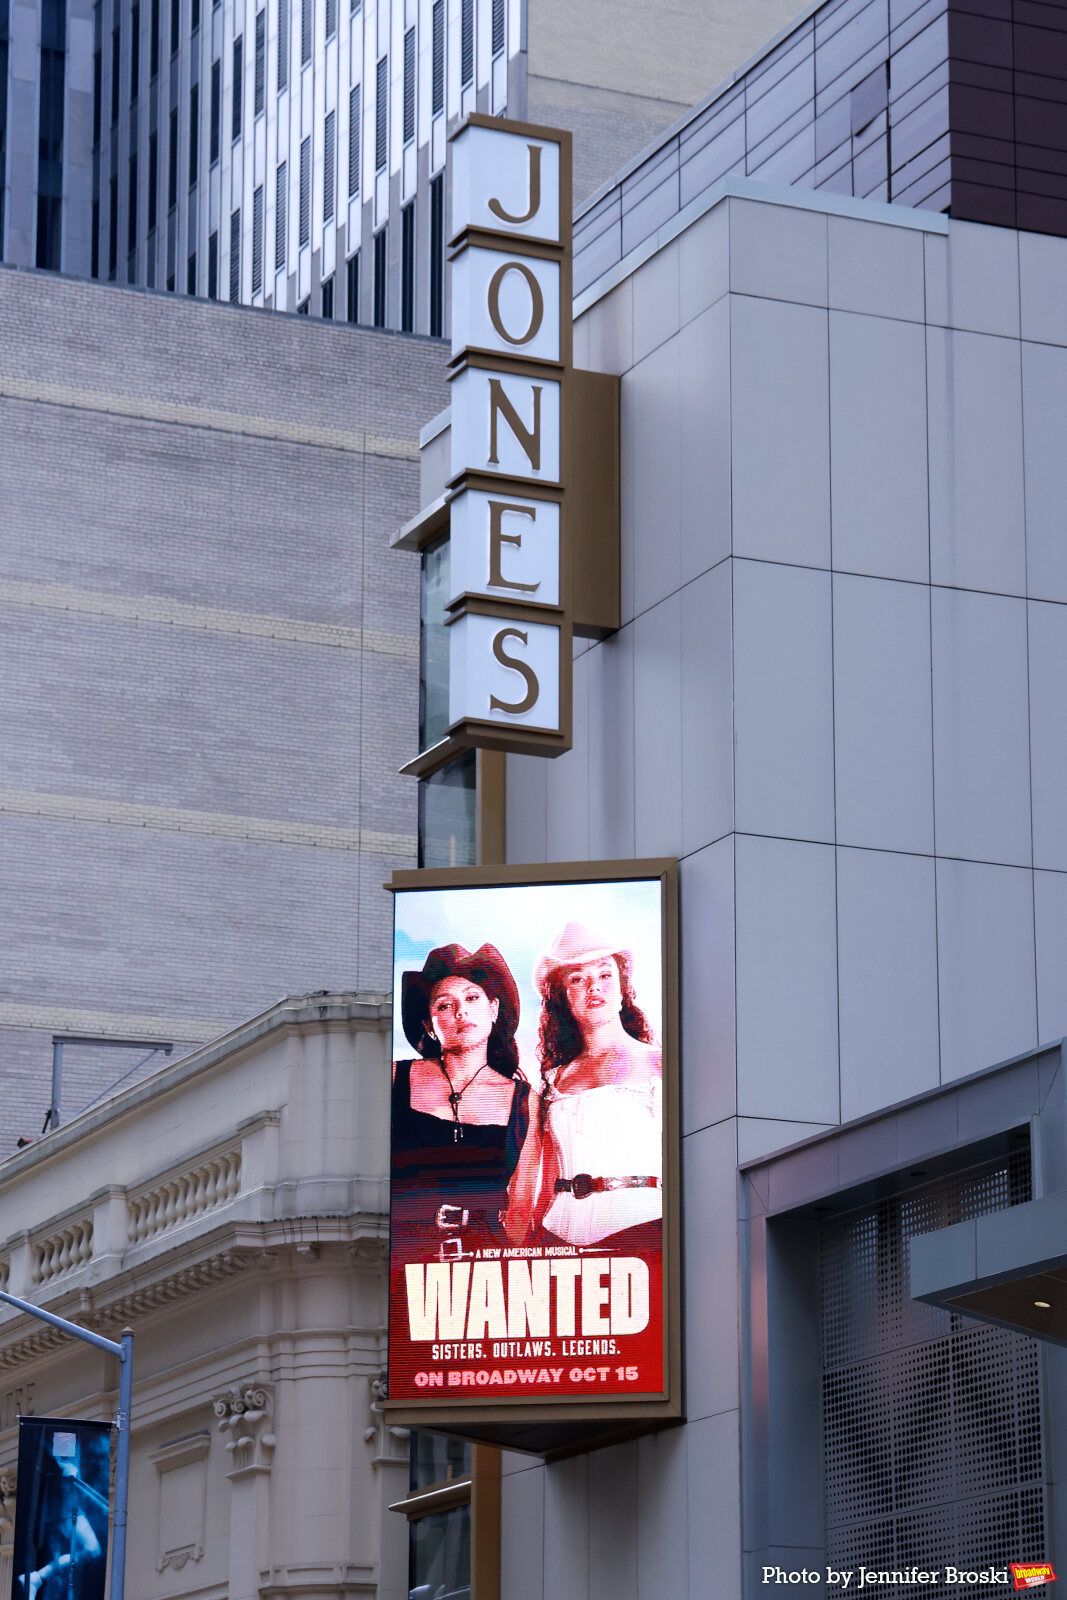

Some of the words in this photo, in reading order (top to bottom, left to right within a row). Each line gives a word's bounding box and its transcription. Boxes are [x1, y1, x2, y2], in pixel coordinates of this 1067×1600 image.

[487, 144, 544, 715] JONES
[475, 1249, 481, 1259] A
[482, 1248, 501, 1258] NEW
[503, 1247, 542, 1258] AMERICAN
[544, 1246, 578, 1257] MUSICAL
[404, 1256, 650, 1342] WANTED
[432, 1343, 487, 1360] SISTERS.
[493, 1341, 556, 1358] OUTLAWS.
[562, 1339, 621, 1357] LEGENDS.
[414, 1371, 443, 1387] ON
[447, 1368, 563, 1387] BROADWAY
[569, 1367, 610, 1382] OCT
[615, 1366, 639, 1381] 15
